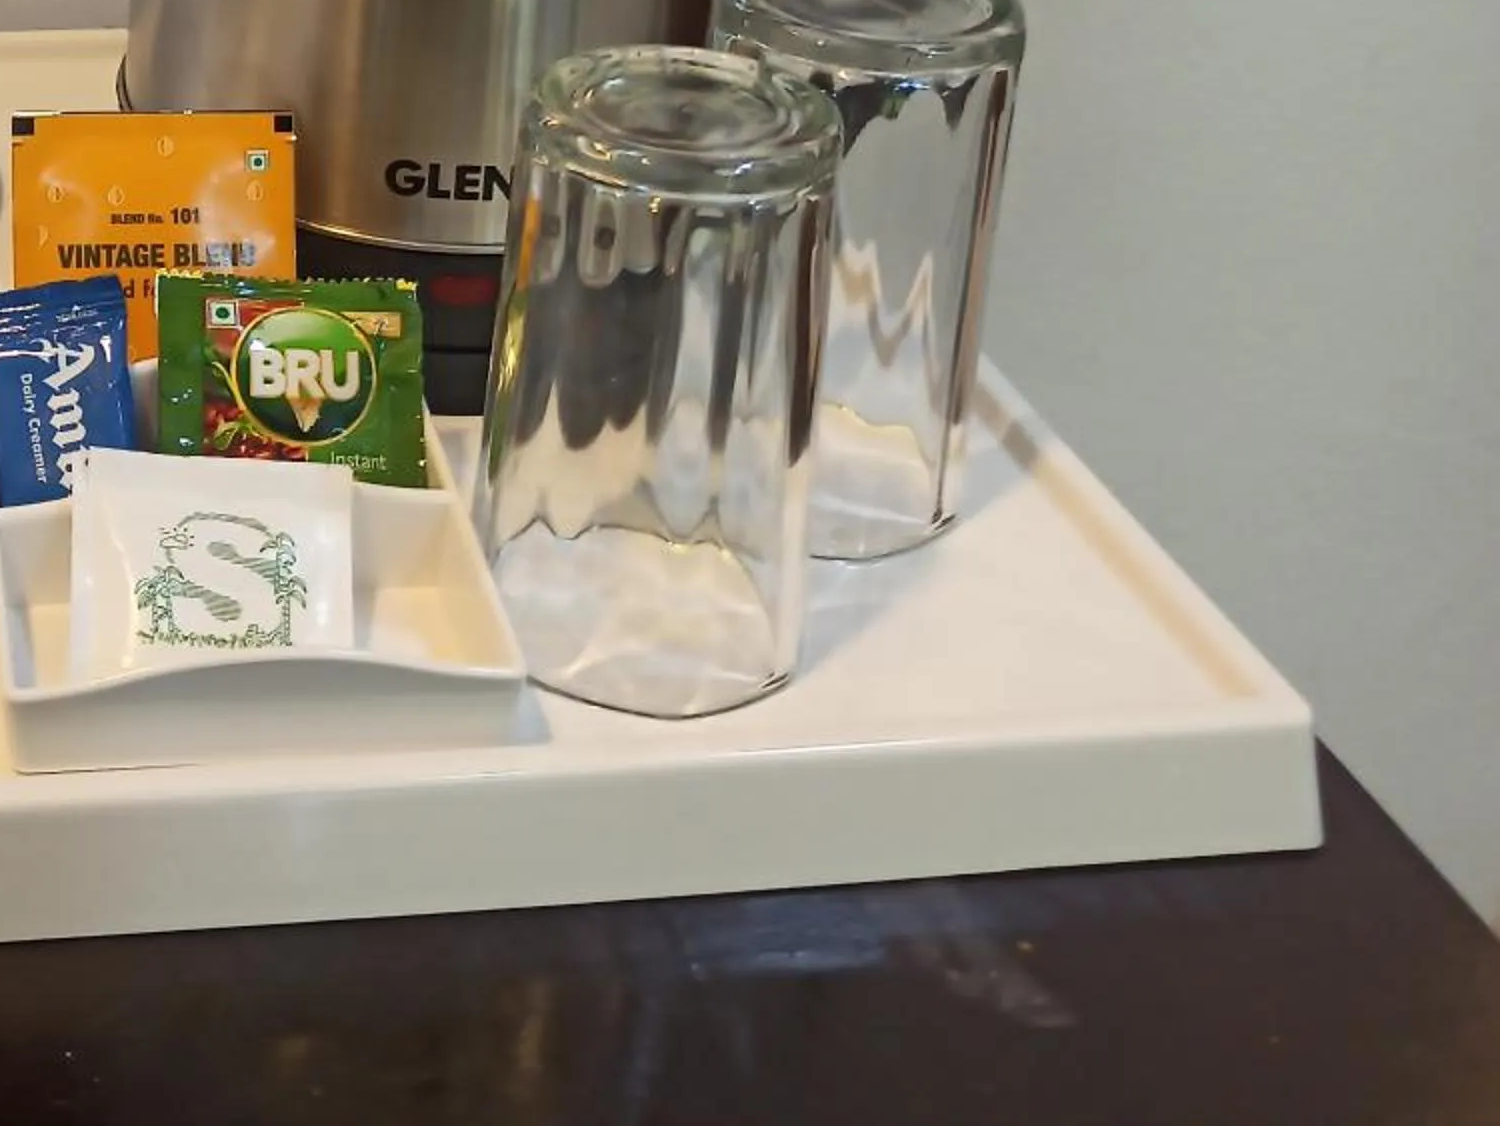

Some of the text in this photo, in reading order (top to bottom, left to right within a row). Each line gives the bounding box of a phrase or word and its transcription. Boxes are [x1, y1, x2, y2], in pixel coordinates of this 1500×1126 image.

[385, 159, 516, 201] GLEN
[170, 208, 200, 224] 101
[58, 244, 164, 268] VINTAGE
[249, 347, 359, 401] BRU
[21, 373, 47, 483] Dairy Creamer
[331, 451, 386, 471] Instant
